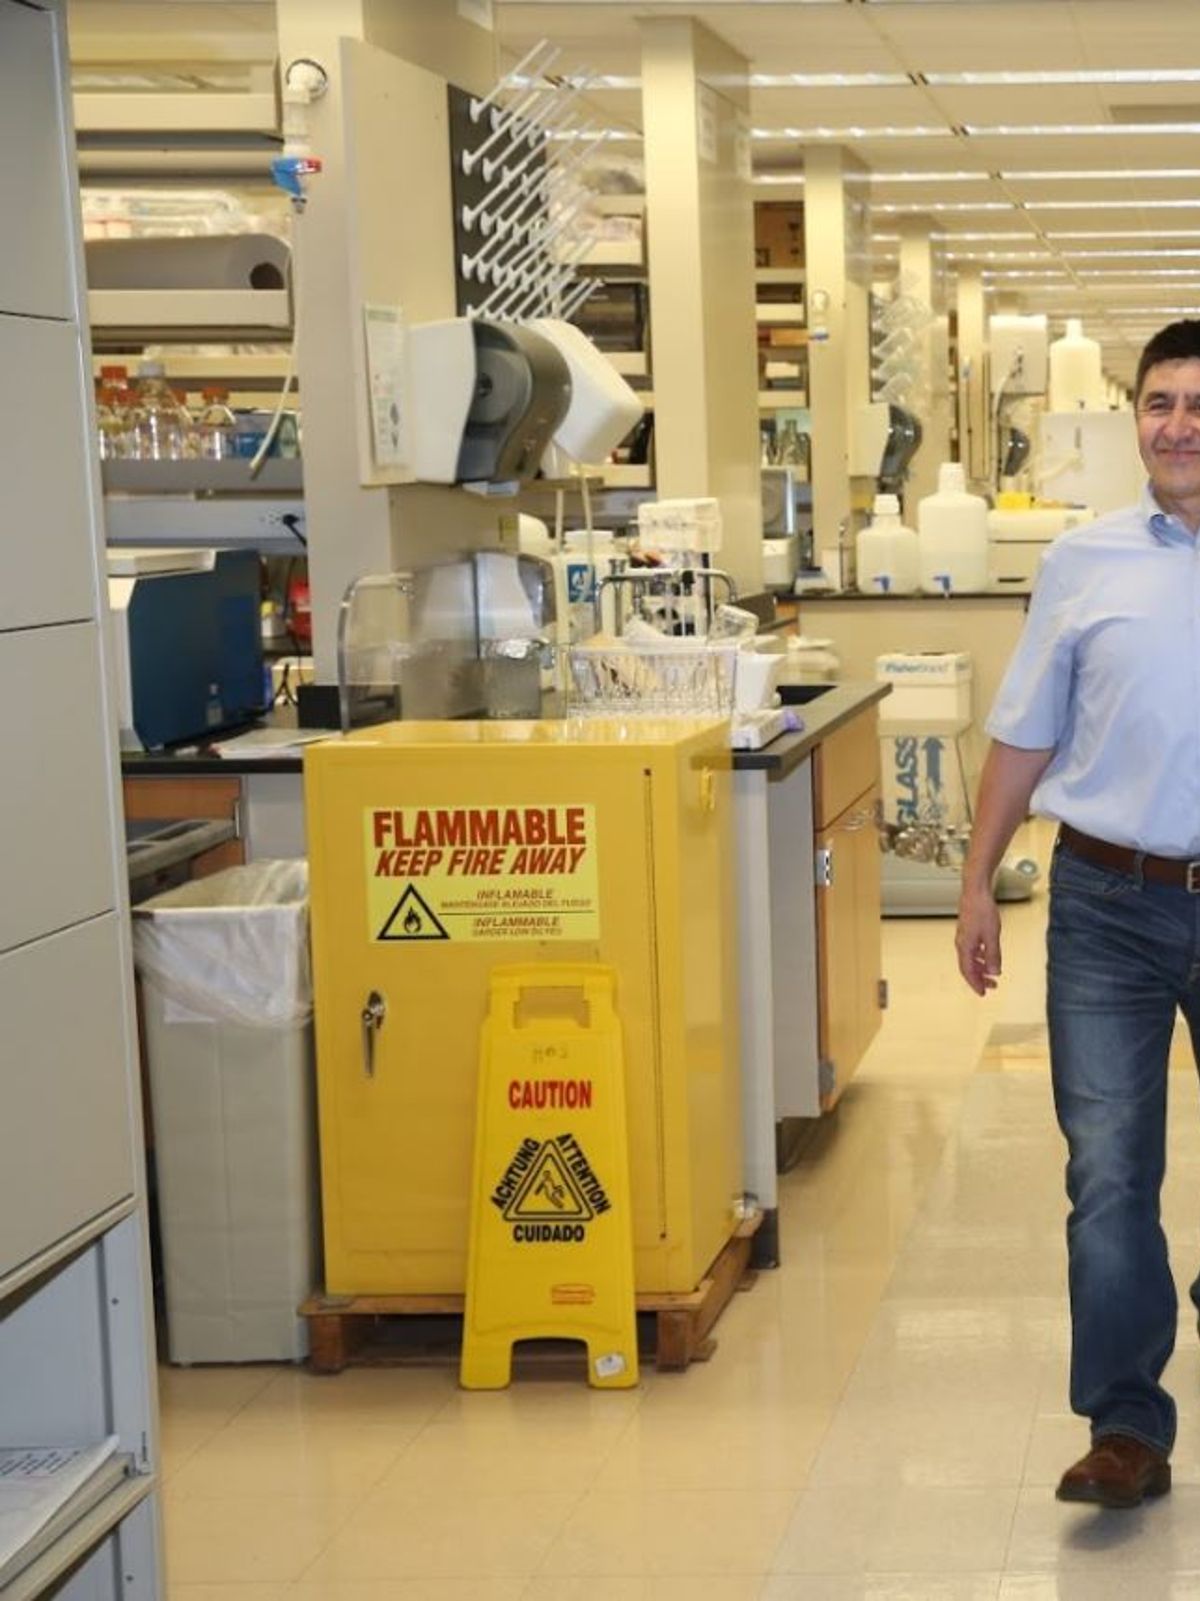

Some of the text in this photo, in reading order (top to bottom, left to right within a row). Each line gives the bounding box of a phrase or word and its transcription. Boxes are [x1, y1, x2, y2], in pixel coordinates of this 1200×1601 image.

[373, 808, 586, 848] FLAMMABLE
[374, 847, 587, 877] KEEP FIRE AWAY
[476, 889, 554, 900] INFLAMABLE
[474, 916, 560, 927] INFLAMMABLE
[508, 1080, 592, 1109] CAUTION
[491, 1137, 541, 1210] ACHTUNG
[556, 1133, 612, 1215] ATTENTION
[513, 1224, 585, 1242] CUIDADO
